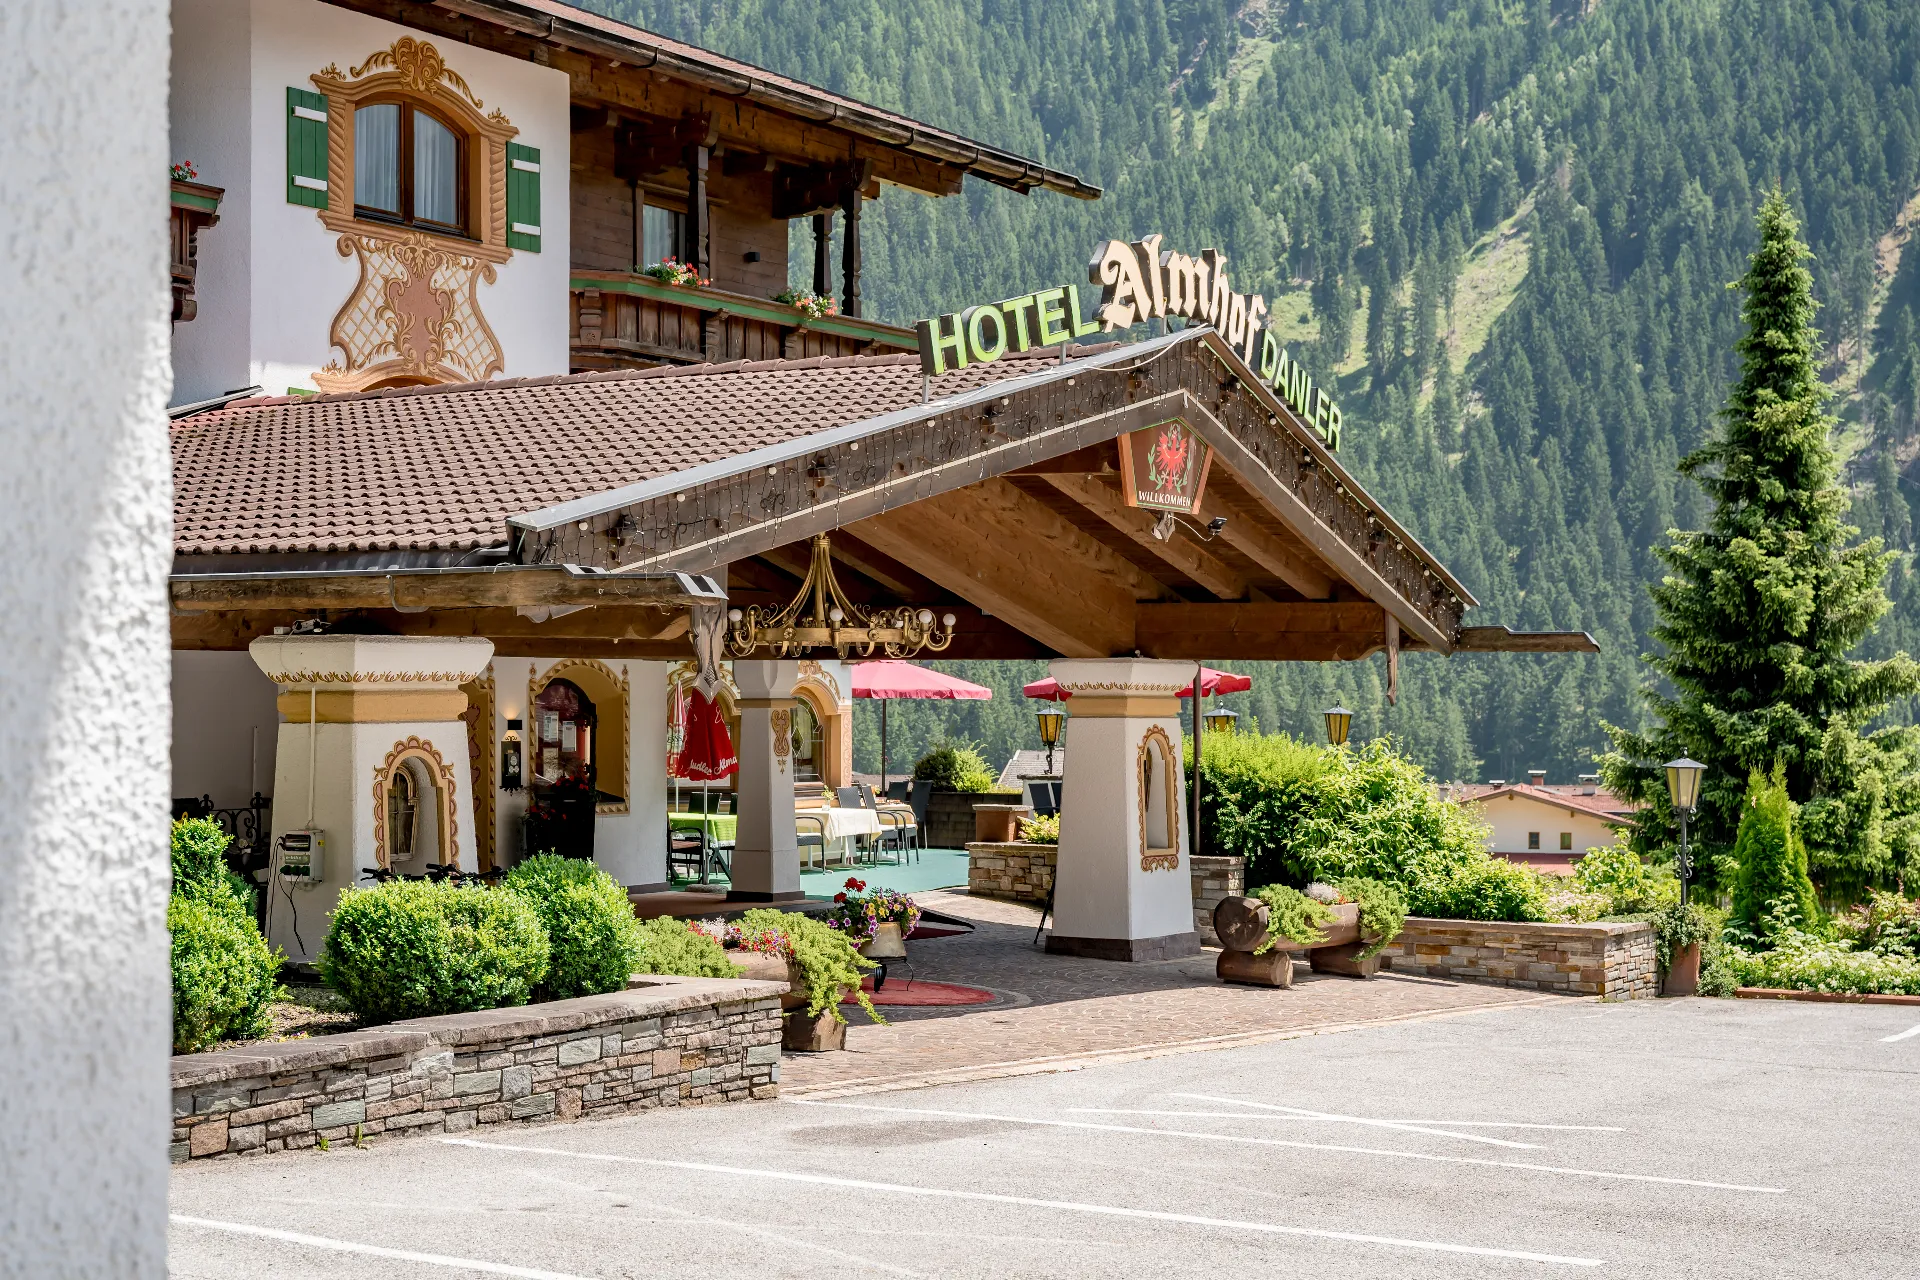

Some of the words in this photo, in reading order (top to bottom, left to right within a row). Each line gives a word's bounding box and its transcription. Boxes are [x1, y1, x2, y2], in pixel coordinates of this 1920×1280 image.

[917, 284, 1100, 375] HOTEL
[1090, 233, 1267, 366] Almhof
[1259, 328, 1343, 453] DANLER
[1138, 490, 1191, 507] WILLKOMMEN
